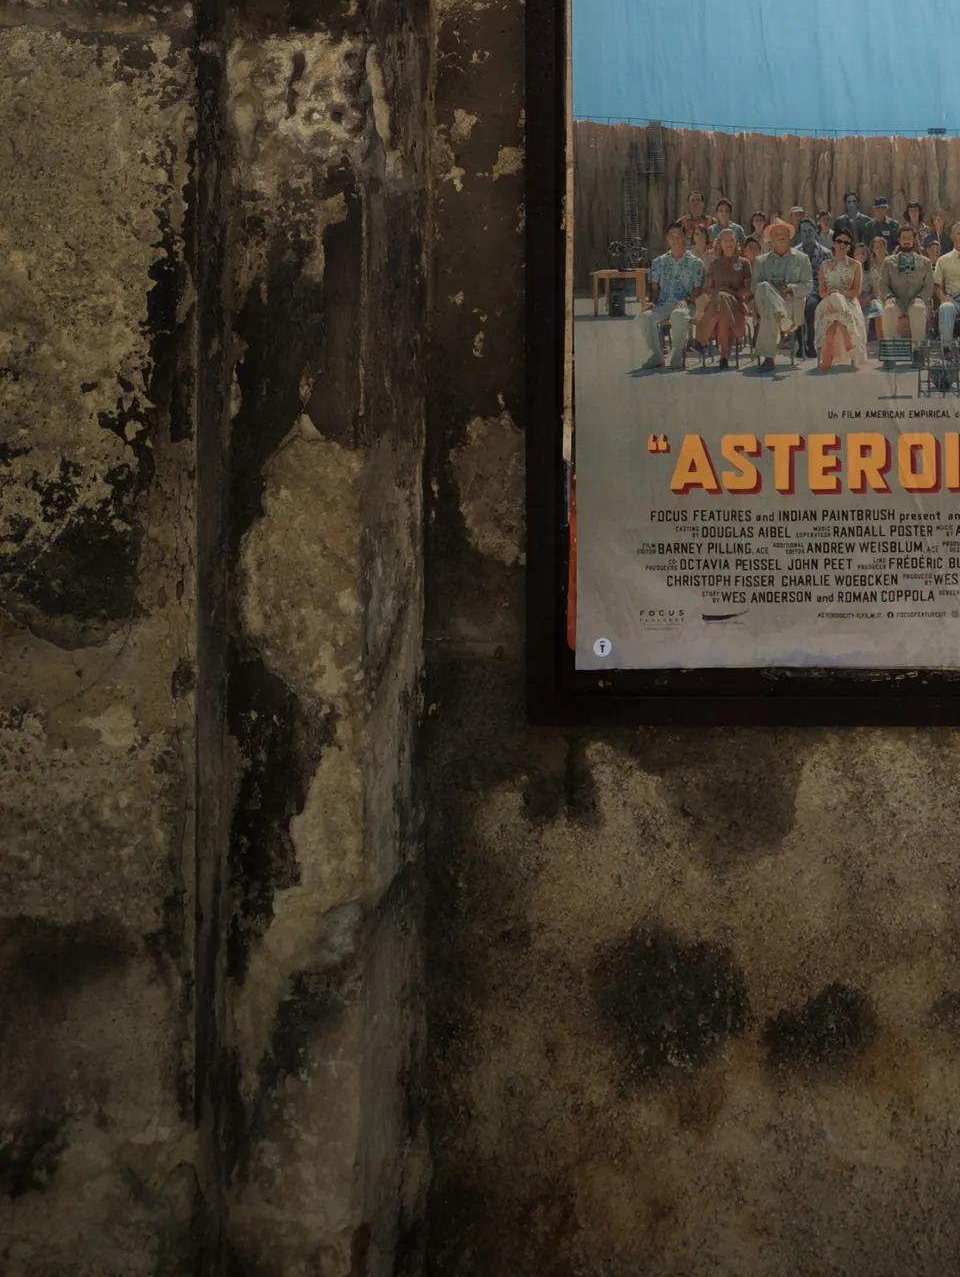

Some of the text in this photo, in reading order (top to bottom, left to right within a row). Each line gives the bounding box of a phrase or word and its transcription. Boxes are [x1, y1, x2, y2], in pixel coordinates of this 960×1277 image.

[828, 411, 839, 419] Un
[842, 410, 861, 419] FILM
[865, 410, 905, 419] AMERICAN
[909, 409, 951, 418] EMPIRICAL
[650, 510, 688, 522] FOCUS
[693, 509, 752, 522] FEATURES
[756, 512, 775, 522] and
[778, 510, 817, 522] INDIAN
[822, 509, 895, 521] PAINTBRUSH
[900, 511, 941, 523] present
[948, 512, 960, 520] an
[701, 526, 754, 538] DOUGLAS
[758, 526, 791, 538] AIBEL
[833, 525, 886, 537] RANDALL
[890, 525, 933, 537] POSTER
[658, 543, 703, 554] BARNEY
[807, 542, 856, 554] ANDREW
[680, 559, 730, 571] OCTAVIA
[736, 559, 782, 571] PEISSEL
[788, 558, 818, 570] JOHN
[824, 558, 853, 570] PEET
[889, 555, 943, 569] FRÉDÉRIC
[667, 575, 731, 587] CHRISTOPH
[735, 575, 775, 587] FISSER
[781, 575, 830, 587] CHARLIE
[835, 574, 898, 587] WOEBCKEN
[934, 573, 958, 585] WES
[721, 592, 746, 603] WES
[751, 591, 812, 603] ANDERSON
[816, 593, 834, 603] and
[837, 591, 877, 603] ROMAN
[881, 590, 935, 602] COPPOLA
